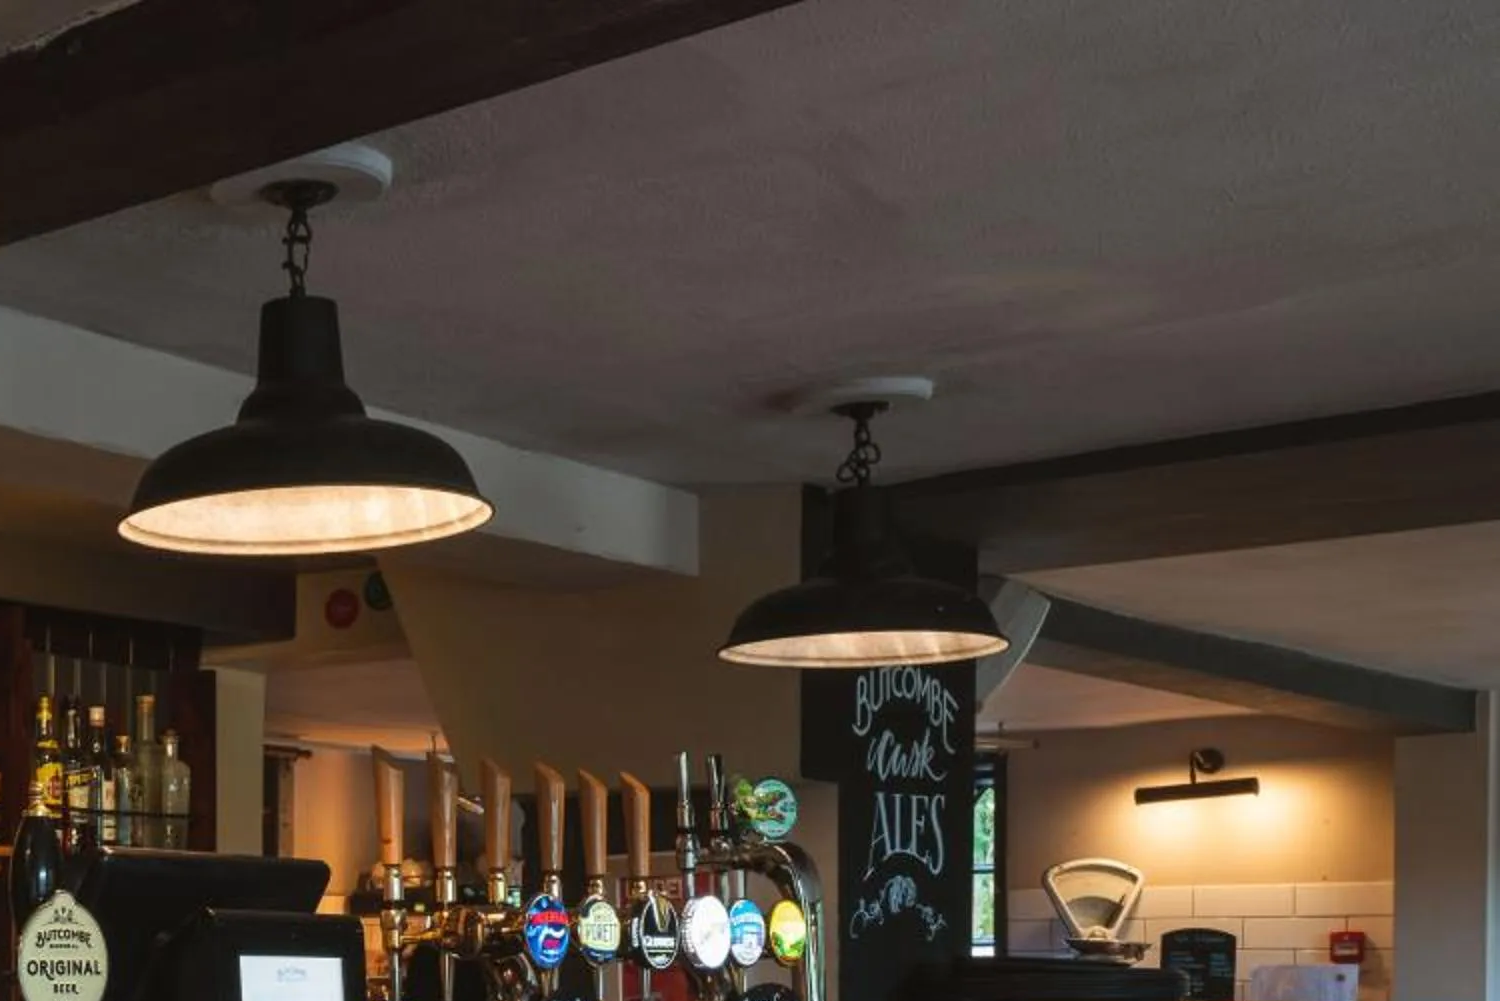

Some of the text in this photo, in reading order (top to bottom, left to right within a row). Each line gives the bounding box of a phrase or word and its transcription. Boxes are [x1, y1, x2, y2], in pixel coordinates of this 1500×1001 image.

[852, 664, 961, 754] BUTCOMBE
[866, 729, 947, 781] Cask
[863, 791, 946, 882] ALES
[35, 929, 93, 948] BUTCOMBE
[26, 960, 102, 980] ORIGINAL
[53, 984, 79, 995] BEER
